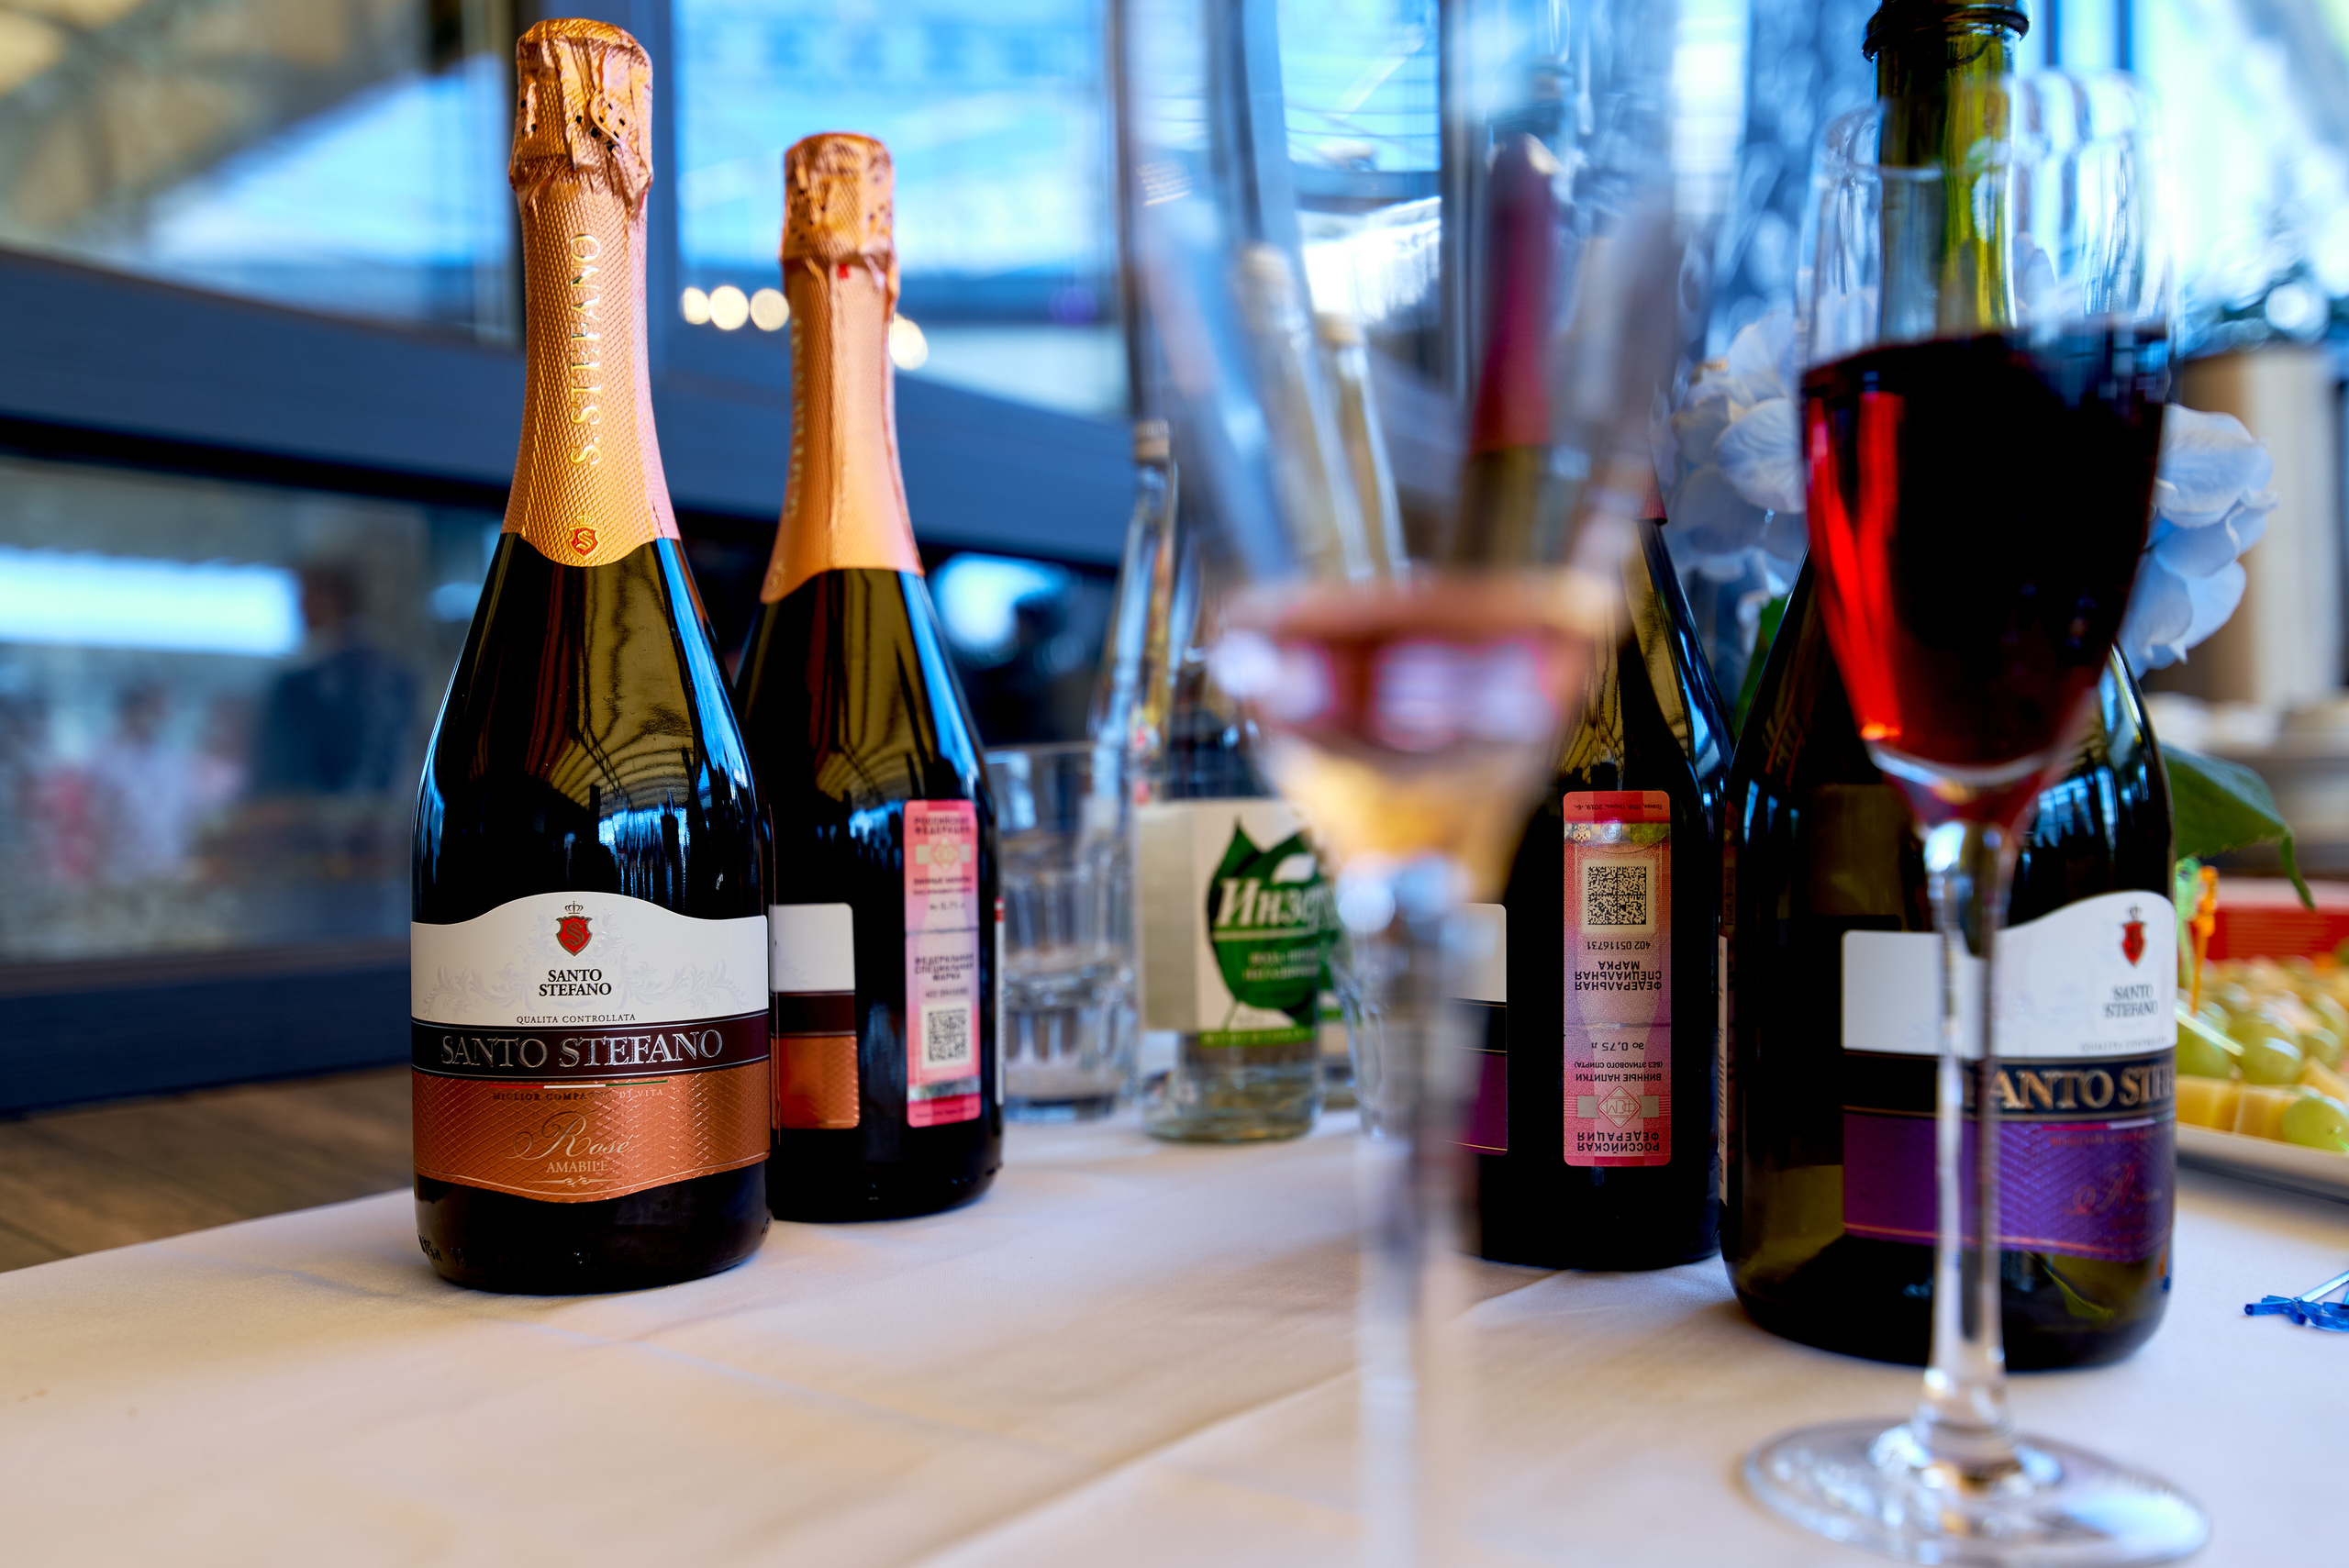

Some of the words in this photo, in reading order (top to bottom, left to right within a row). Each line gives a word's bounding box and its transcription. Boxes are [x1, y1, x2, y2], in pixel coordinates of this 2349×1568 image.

[570, 233, 602, 425] STEFANO
[570, 437, 602, 466] S.
[1586, 940, 1632, 951] 05116731
[1634, 940, 1651, 950] 402
[1598, 961, 1640, 971] МАРКА
[548, 969, 602, 983] SANTO
[1575, 971, 1662, 981] СПЕЦИАЛЬНАЯ
[539, 982, 612, 996] STEFANO
[1575, 981, 1662, 991] ФЕДЕРАЛЬНАЯ
[2112, 984, 2154, 1001] SANTO
[2104, 1000, 2159, 1018] STEFANO
[562, 1013, 636, 1024] CONTROLLATA
[440, 1034, 548, 1068] SANTO
[558, 1029, 723, 1068] STEFANO
[1602, 1041, 1629, 1051] 0,75
[1575, 1073, 1620, 1083] НАПИТКИ
[1623, 1073, 1662, 1082] ВИННЫЕ
[493, 1092, 540, 1101] MIGLIOR
[545, 1092, 614, 1101] COMPAGNO
[618, 1090, 632, 1099] DI
[637, 1089, 664, 1098] VITA
[1975, 1068, 2114, 1111] ANTO
[505, 1110, 635, 1160] Rosé
[1577, 1130, 1660, 1141] ФЕДЕРАЦИЯ
[1577, 1142, 1660, 1154] РОССИЙСКАЯ
[546, 1161, 608, 1173] AMABILE
